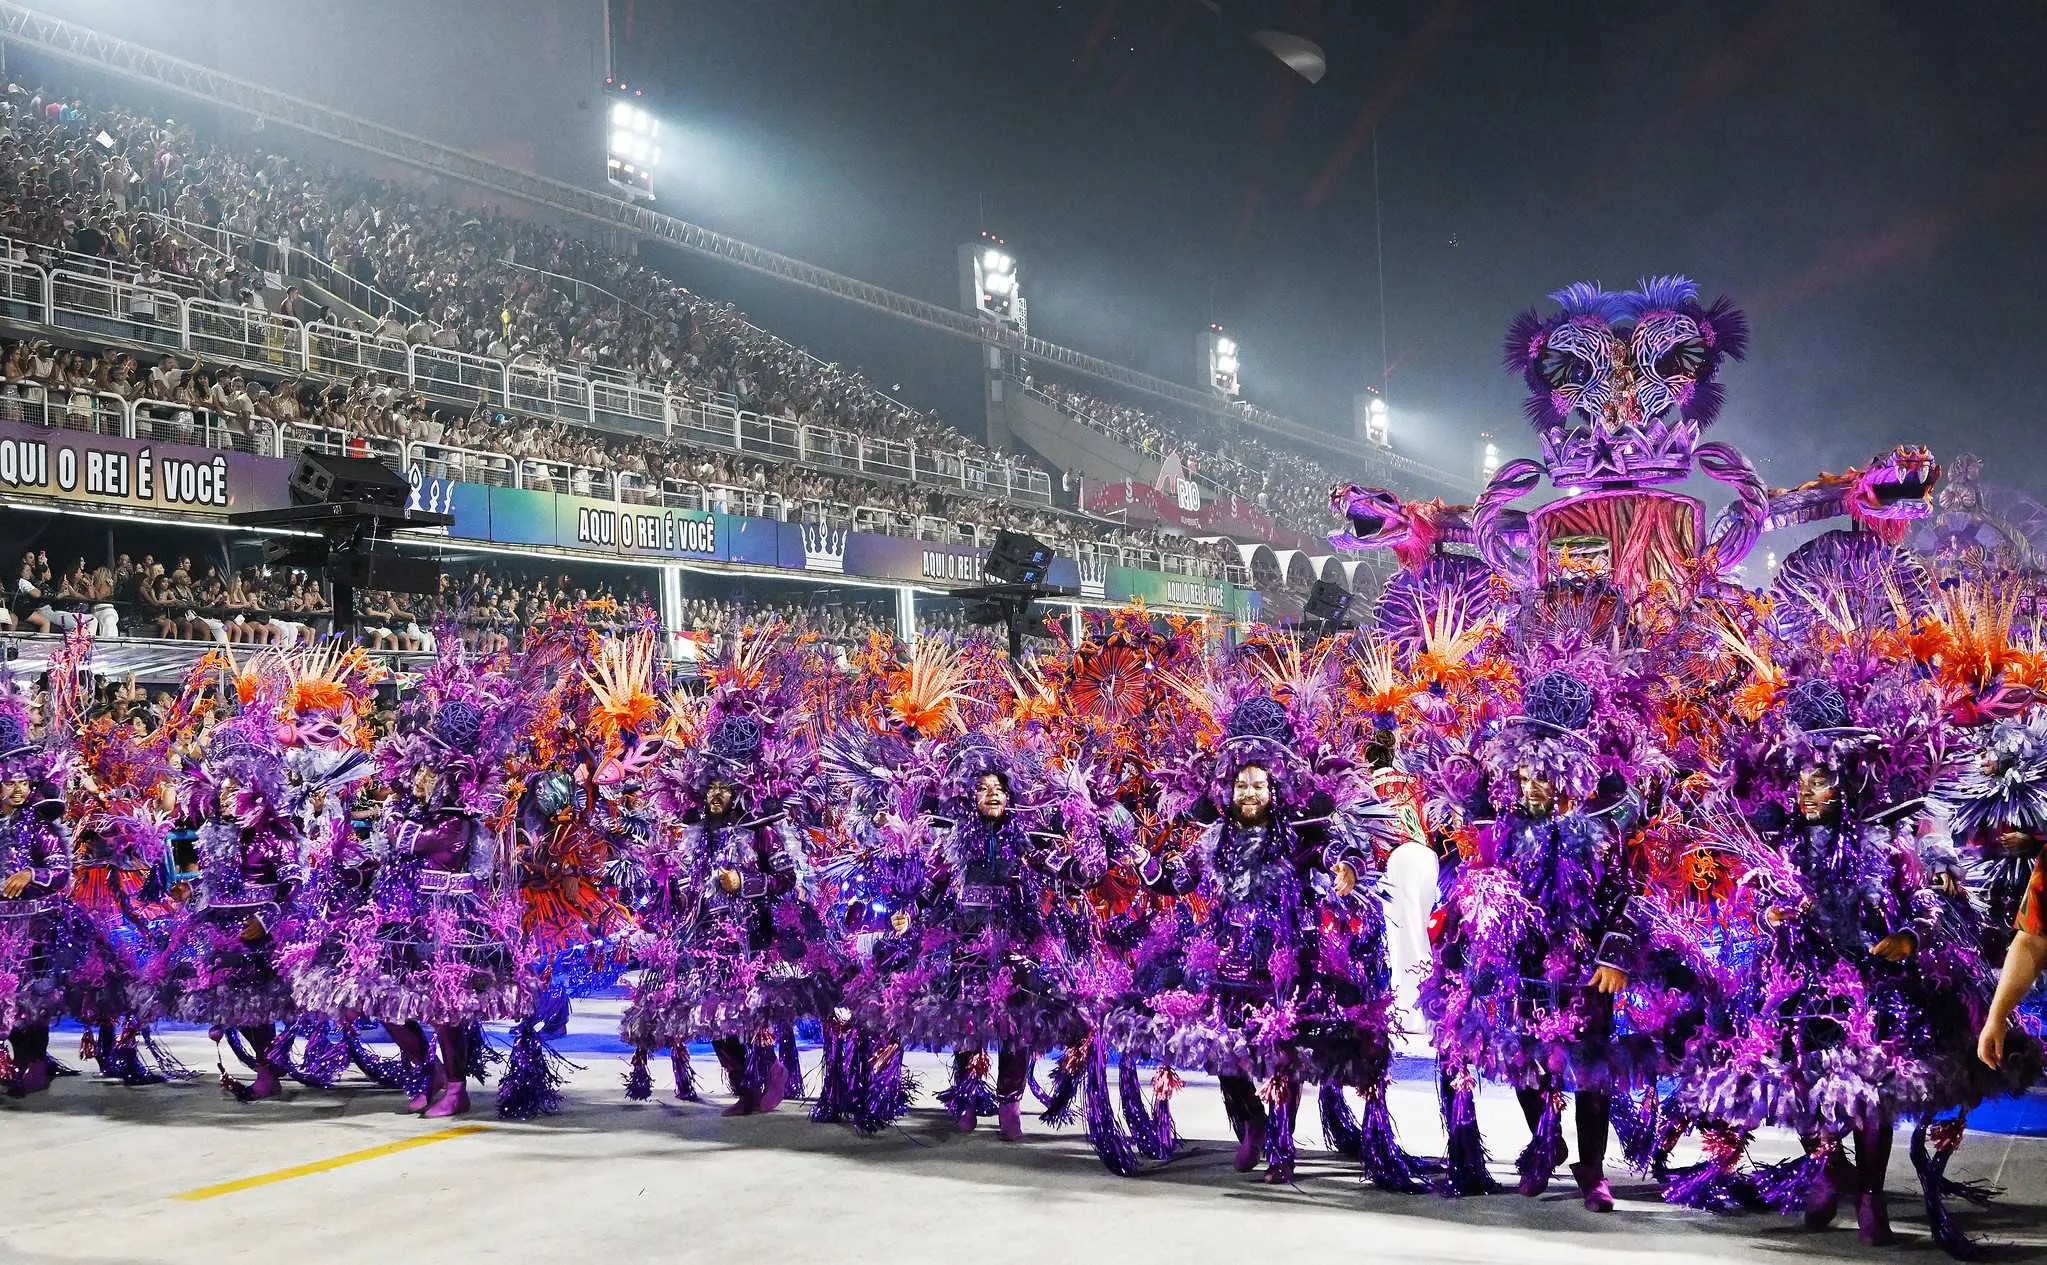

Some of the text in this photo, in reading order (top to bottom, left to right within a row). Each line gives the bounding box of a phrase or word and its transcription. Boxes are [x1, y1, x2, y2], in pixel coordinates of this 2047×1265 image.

[58, 448, 77, 491] O
[87, 450, 128, 496] REI
[138, 449, 152, 498] É
[163, 456, 227, 505] VOCÊ
[1177, 478, 1200, 511] RIO
[579, 508, 716, 553] AQUI O REI É VOCÊ
[923, 551, 945, 579] AQUI
[948, 554, 955, 579] O
[957, 555, 973, 580] REI
[975, 552, 981, 581] É
[1167, 581, 1182, 604] AQUI
[1184, 583, 1189, 603] O
[1190, 583, 1201, 604] REI
[1208, 583, 1224, 607] VOCÊ
